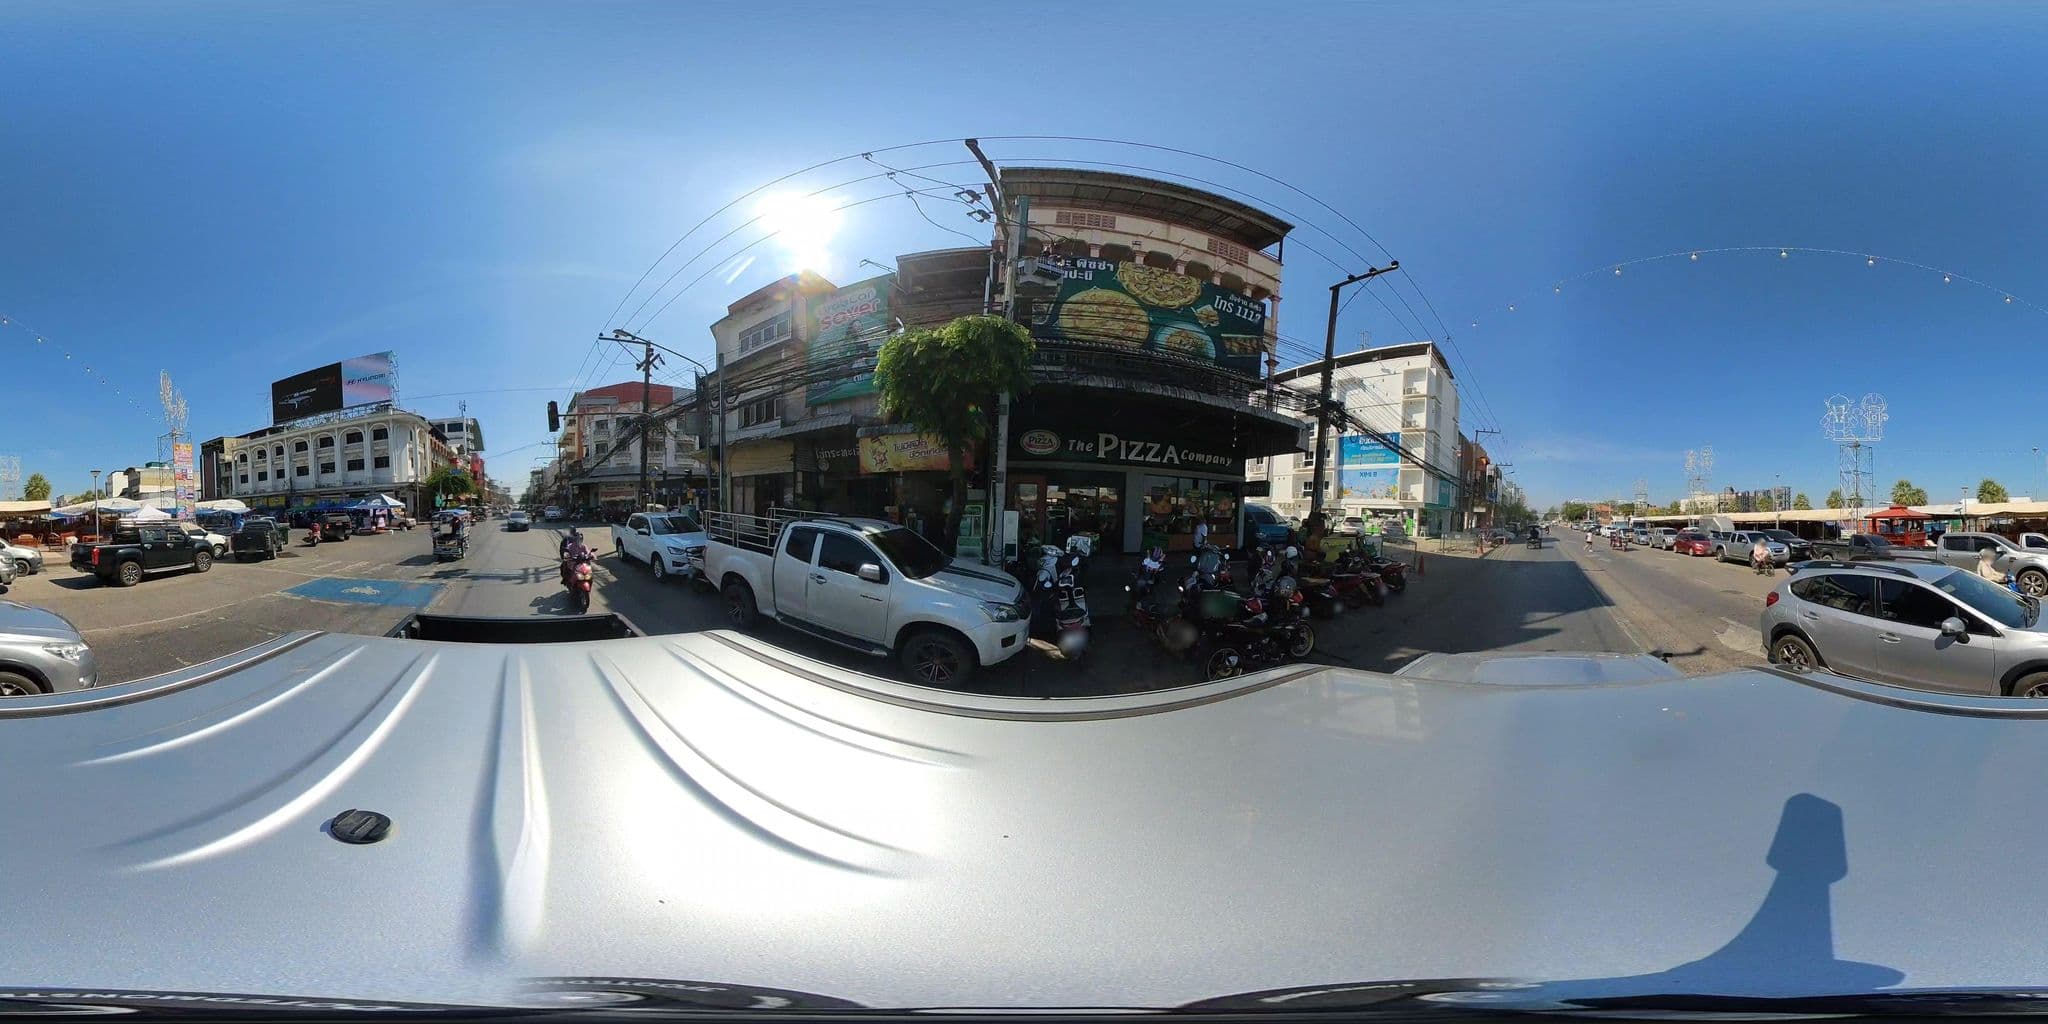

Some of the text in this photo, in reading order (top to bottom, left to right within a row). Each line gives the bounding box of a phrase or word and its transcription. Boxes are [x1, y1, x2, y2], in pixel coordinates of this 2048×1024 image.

[1214, 294, 1234, 313] โทร
[1068, 432, 1233, 467] The PIZZA Company
